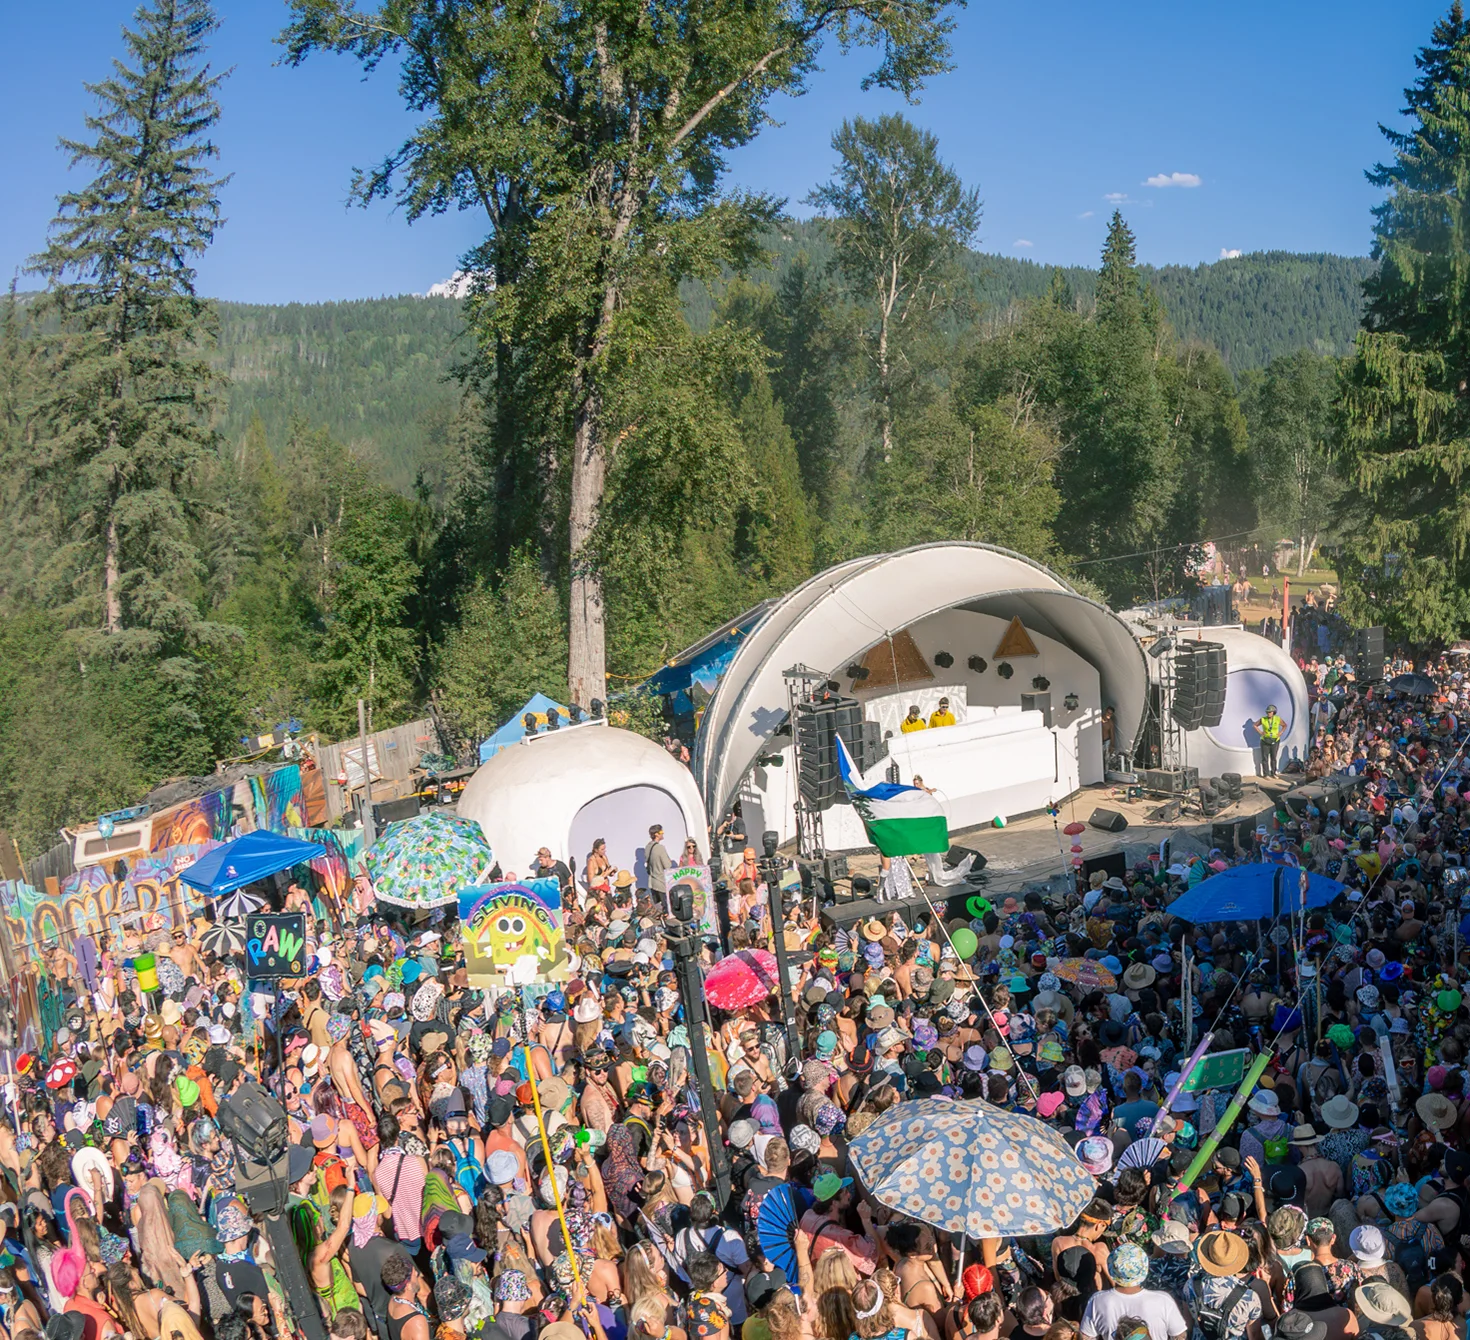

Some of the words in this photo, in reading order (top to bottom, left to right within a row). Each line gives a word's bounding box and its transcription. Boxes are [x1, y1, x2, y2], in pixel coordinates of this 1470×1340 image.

[672, 867, 703, 881] HAPPY
[471, 895, 550, 929] SLIVING
[247, 924, 304, 967] RAW
